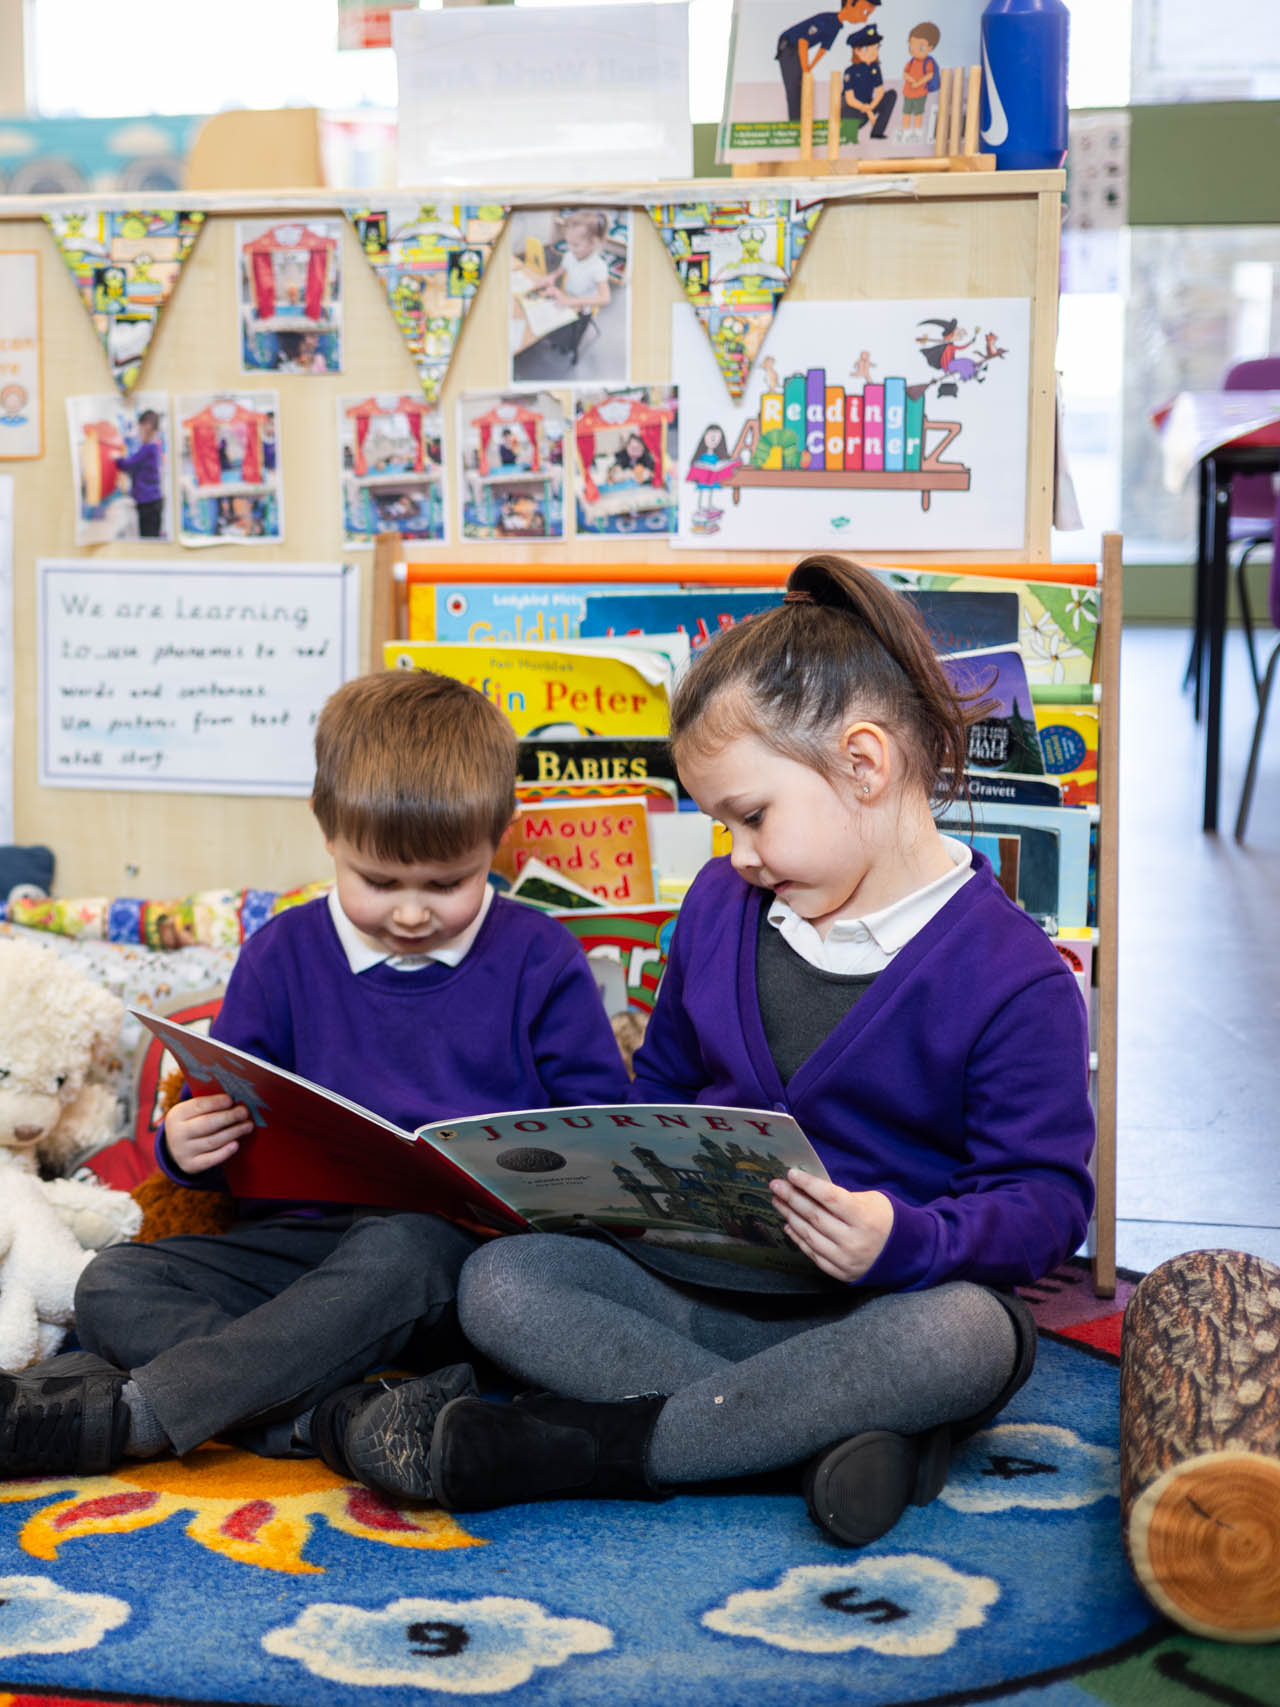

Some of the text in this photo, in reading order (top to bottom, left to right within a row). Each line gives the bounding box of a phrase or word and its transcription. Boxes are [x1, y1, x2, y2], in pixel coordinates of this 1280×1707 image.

[0, 336, 35, 352] can
[763, 399, 905, 429] Reading
[806, 431, 920, 456] Corner
[61, 594, 309, 630] We are learning
[131, 683, 163, 699] and
[543, 680, 648, 714] Peter
[193, 711, 234, 734] from
[969, 738, 1008, 750] HALF
[969, 749, 1008, 761] PRICE
[536, 751, 648, 781] BABIES
[968, 780, 1017, 798] Gravett
[524, 816, 634, 840] Mouse
[614, 851, 633, 867] a
[480, 1113, 775, 1142] JOURNEY
[981, 1456, 1059, 1480] 4
[821, 1586, 910, 1625] 5
